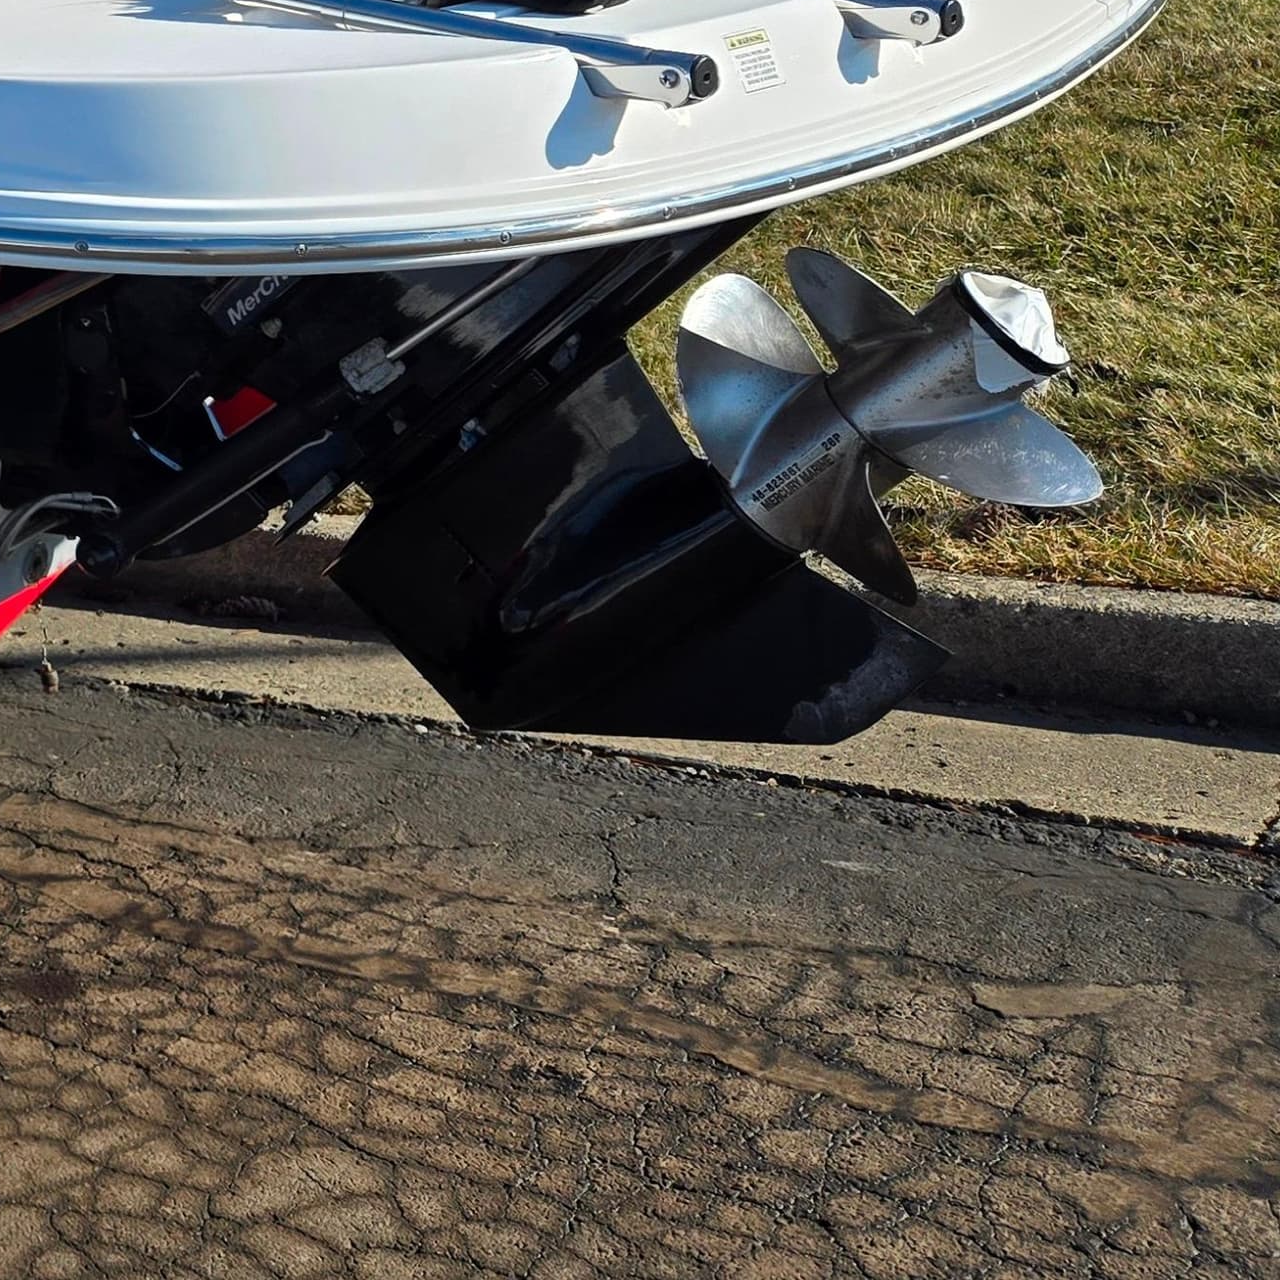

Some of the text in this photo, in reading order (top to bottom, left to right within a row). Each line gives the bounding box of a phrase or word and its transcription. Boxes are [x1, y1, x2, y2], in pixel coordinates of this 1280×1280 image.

[226, 274, 289, 326] MerCr
[760, 453, 835, 512] MERCURY MARINE
